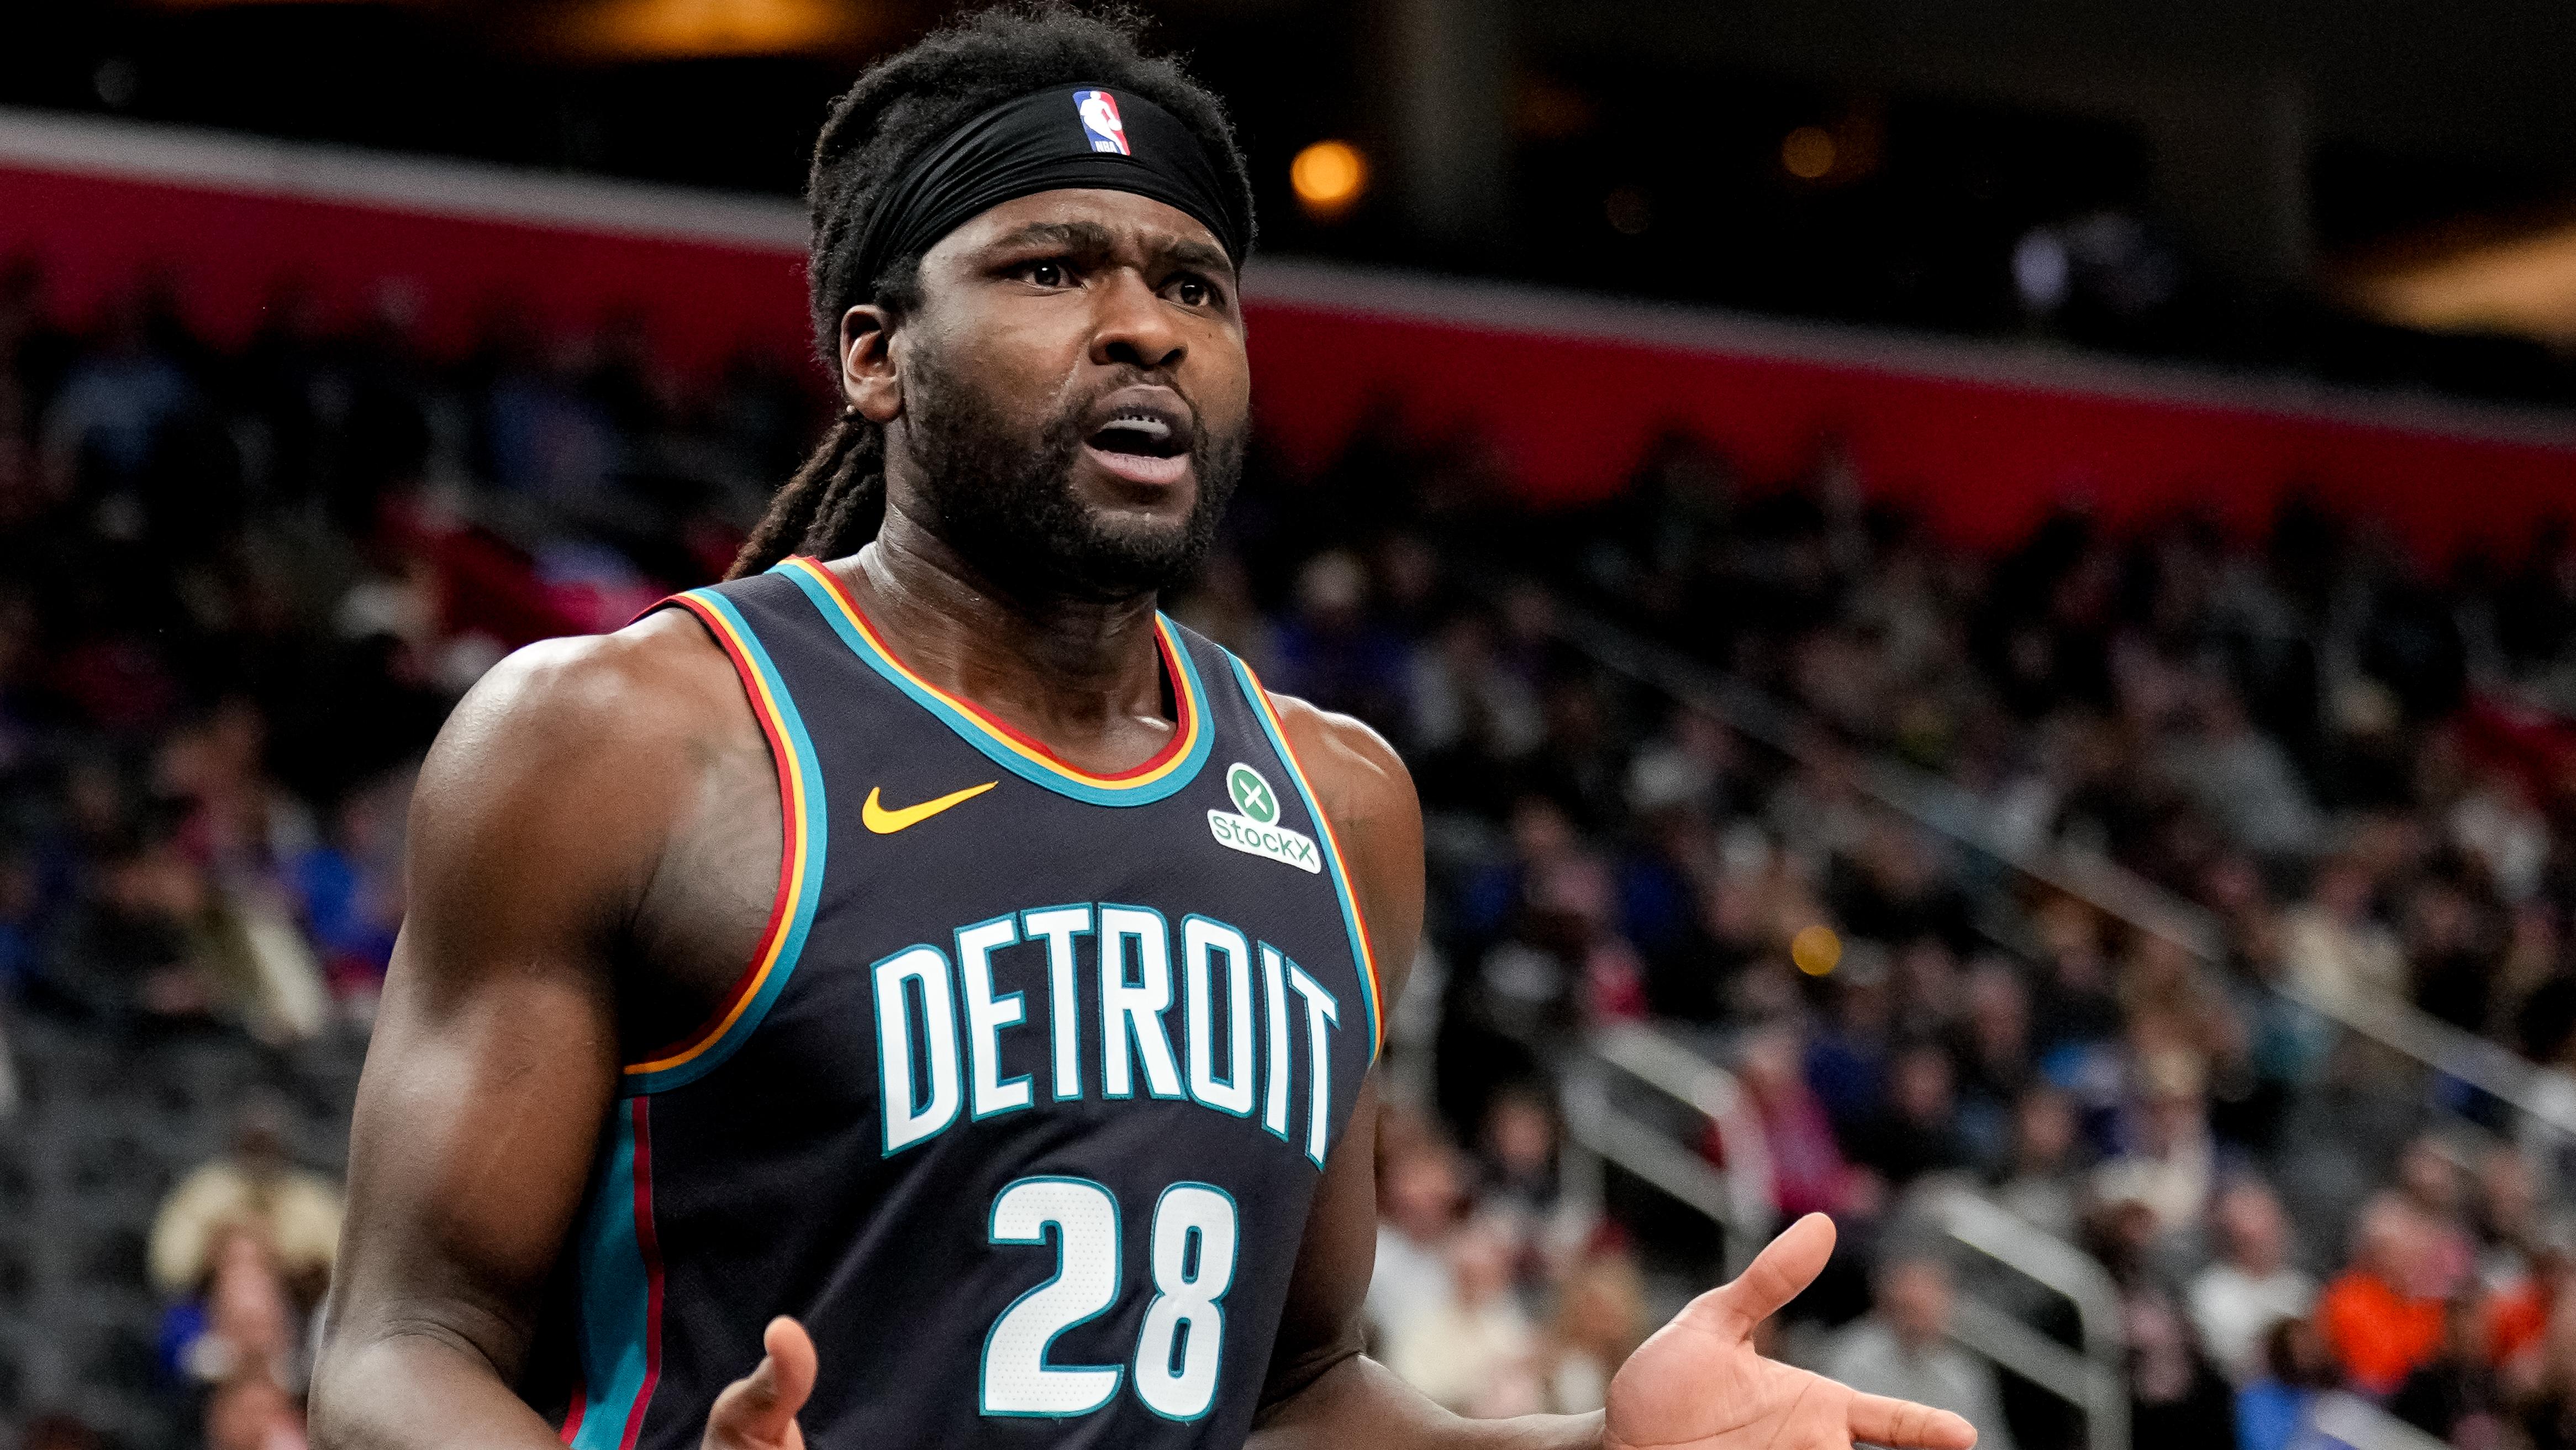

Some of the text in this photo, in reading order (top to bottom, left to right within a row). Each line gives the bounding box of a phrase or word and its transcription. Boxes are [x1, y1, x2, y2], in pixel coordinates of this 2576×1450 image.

[1094, 141, 1118, 153] NBA
[870, 902, 1340, 1171] DETROIT
[979, 1175, 1239, 1422] 28
